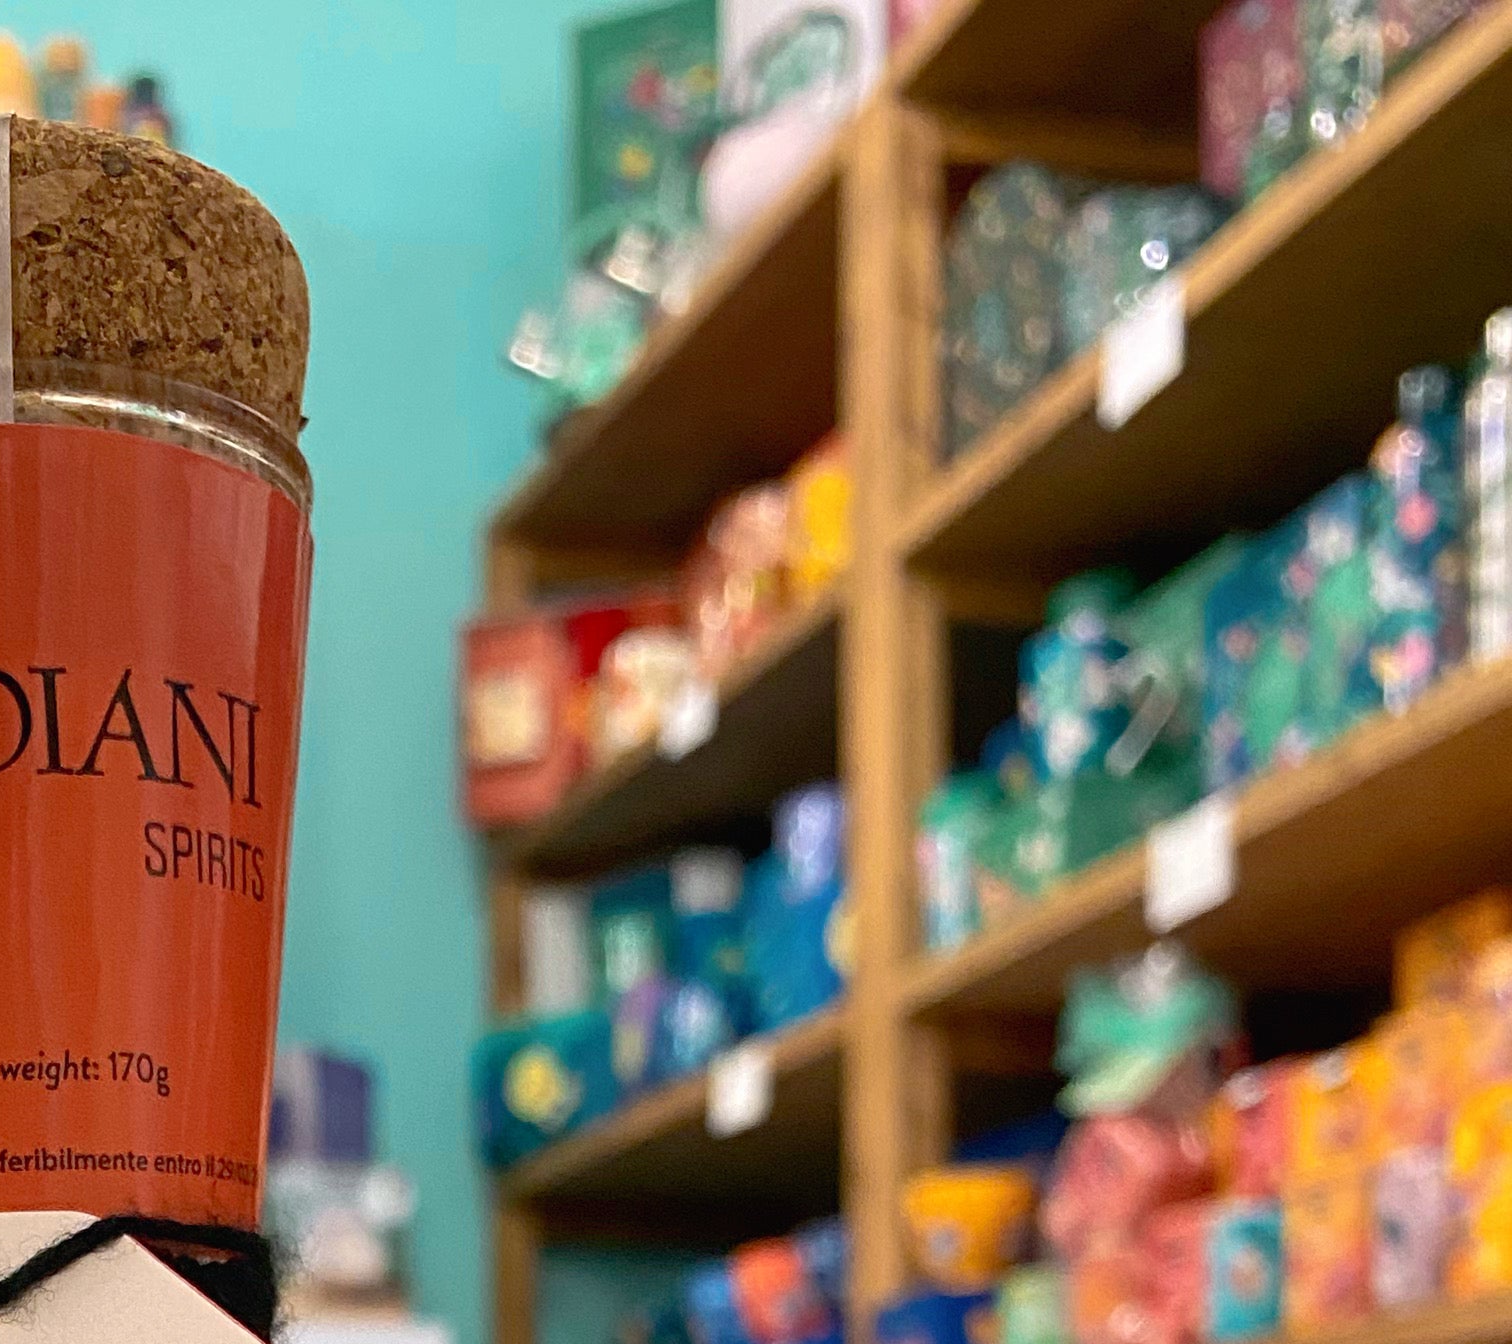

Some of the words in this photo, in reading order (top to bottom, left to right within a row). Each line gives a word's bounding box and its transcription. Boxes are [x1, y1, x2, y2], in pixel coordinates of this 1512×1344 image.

[144, 821, 265, 903] SPIRITS
[0, 1049, 100, 1091] weight:
[107, 1051, 171, 1098] 170g
[153, 1154, 202, 1176] entro
